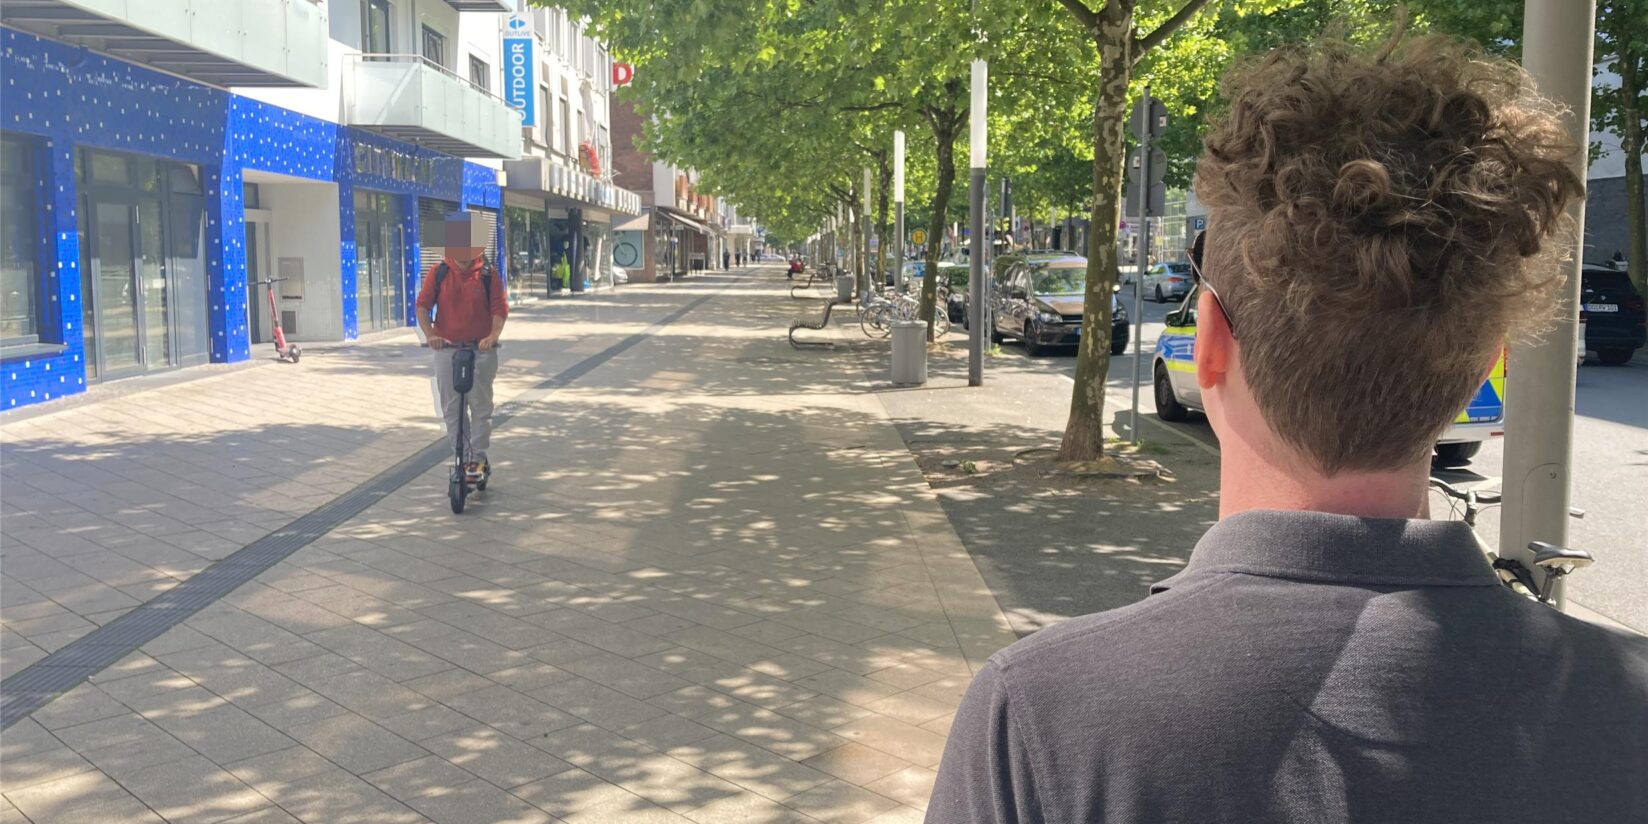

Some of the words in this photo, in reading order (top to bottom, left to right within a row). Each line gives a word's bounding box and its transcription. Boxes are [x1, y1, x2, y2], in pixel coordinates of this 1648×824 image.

[511, 43, 527, 121] OUTDOOR
[613, 63, 632, 85] D
[1196, 219, 1204, 229] P
[915, 231, 923, 242] H
